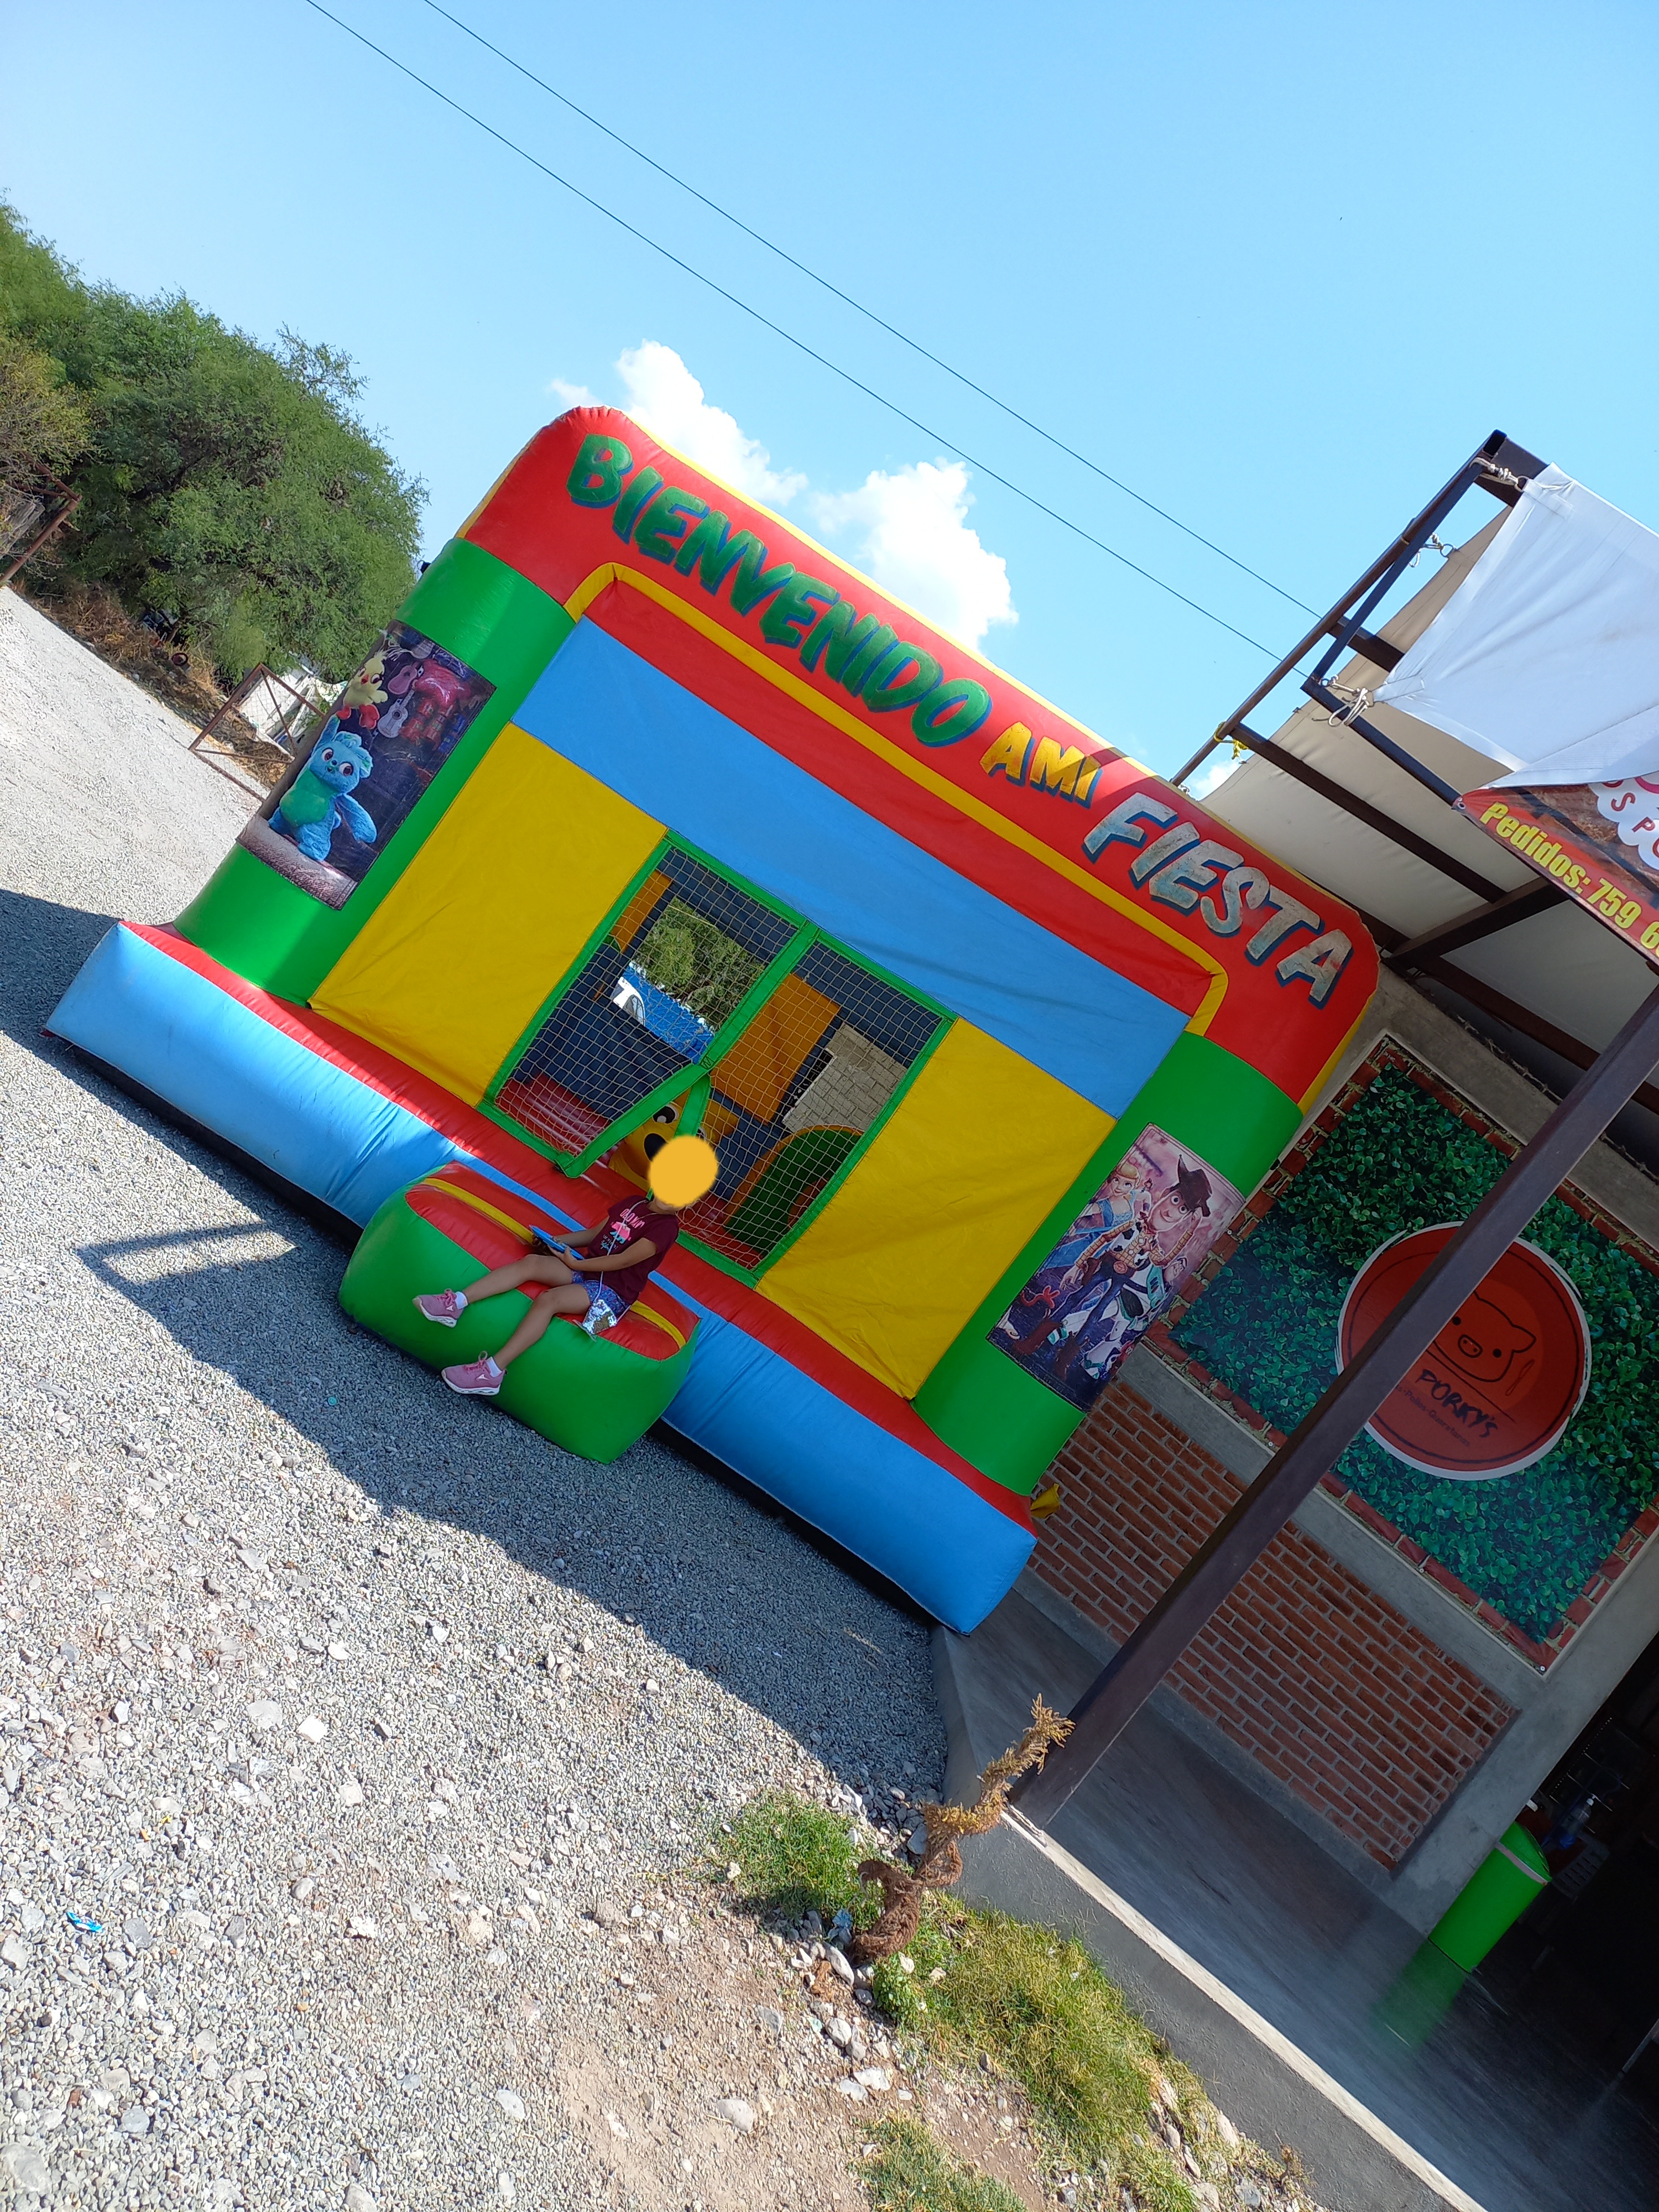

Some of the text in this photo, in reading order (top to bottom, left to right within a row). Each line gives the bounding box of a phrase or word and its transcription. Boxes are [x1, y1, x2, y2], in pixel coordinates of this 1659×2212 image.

[566, 434, 992, 748] BIENVENIDO
[1082, 792, 1354, 1009] FIESTA
[1479, 801, 1592, 894] Pedidos:
[1586, 878, 1642, 930] 759
[1415, 1369, 1498, 1438] PORKY'S
